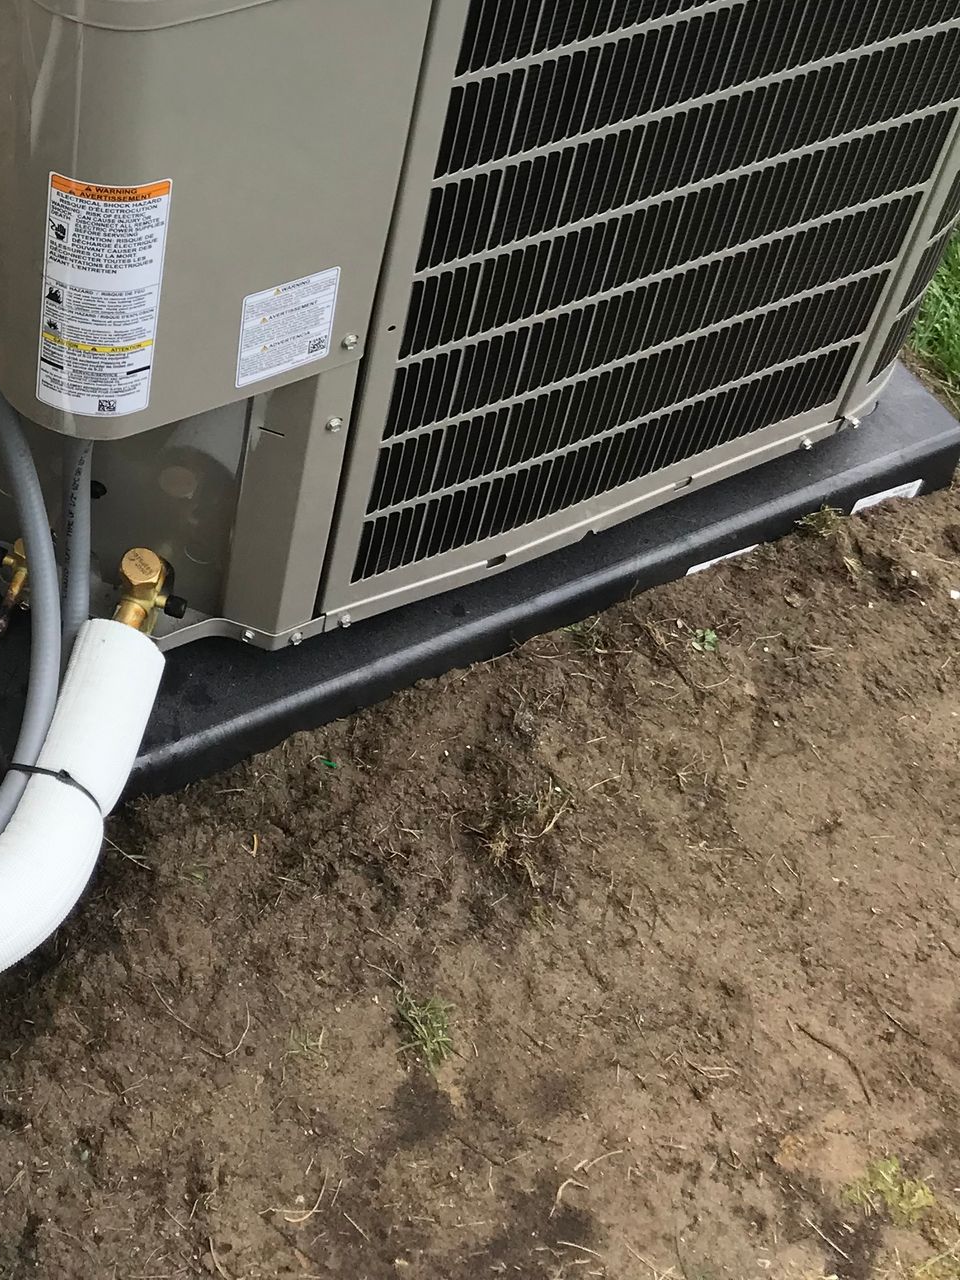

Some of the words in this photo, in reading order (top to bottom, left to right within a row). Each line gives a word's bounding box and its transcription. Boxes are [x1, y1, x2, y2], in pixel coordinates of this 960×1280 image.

[95, 186, 137, 195] WARNING
[56, 191, 101, 207] ELECTRICAL
[132, 197, 162, 208] HAZARD
[80, 192, 152, 202] AVERTISSEMENT
[59, 198, 86, 210] RISQUE
[85, 210, 101, 218] RISK
[114, 211, 147, 219] ELECTRIC
[74, 223, 107, 233] ELECTRIC
[134, 221, 165, 232] SUPPLIES
[75, 218, 119, 229] DISCONNECT
[134, 218, 160, 227] REMOTE
[74, 228, 101, 237] BEFORE
[49, 239, 91, 256] BLESSURES
[71, 242, 105, 253] POUVANT
[106, 246, 137, 254] CAUSER
[138, 244, 153, 252] DES
[48, 255, 71, 266] AVANT
[71, 263, 117, 274] L'ENTRETIEN
[49, 250, 103, 269] ALIMENTATIONS
[69, 285, 94, 295] HAZARD
[281, 279, 311, 292] WARNING
[74, 309, 97, 319] HAZARD
[268, 299, 318, 320] AVERTISSEMENT
[110, 343, 142, 352] ATTENTION
